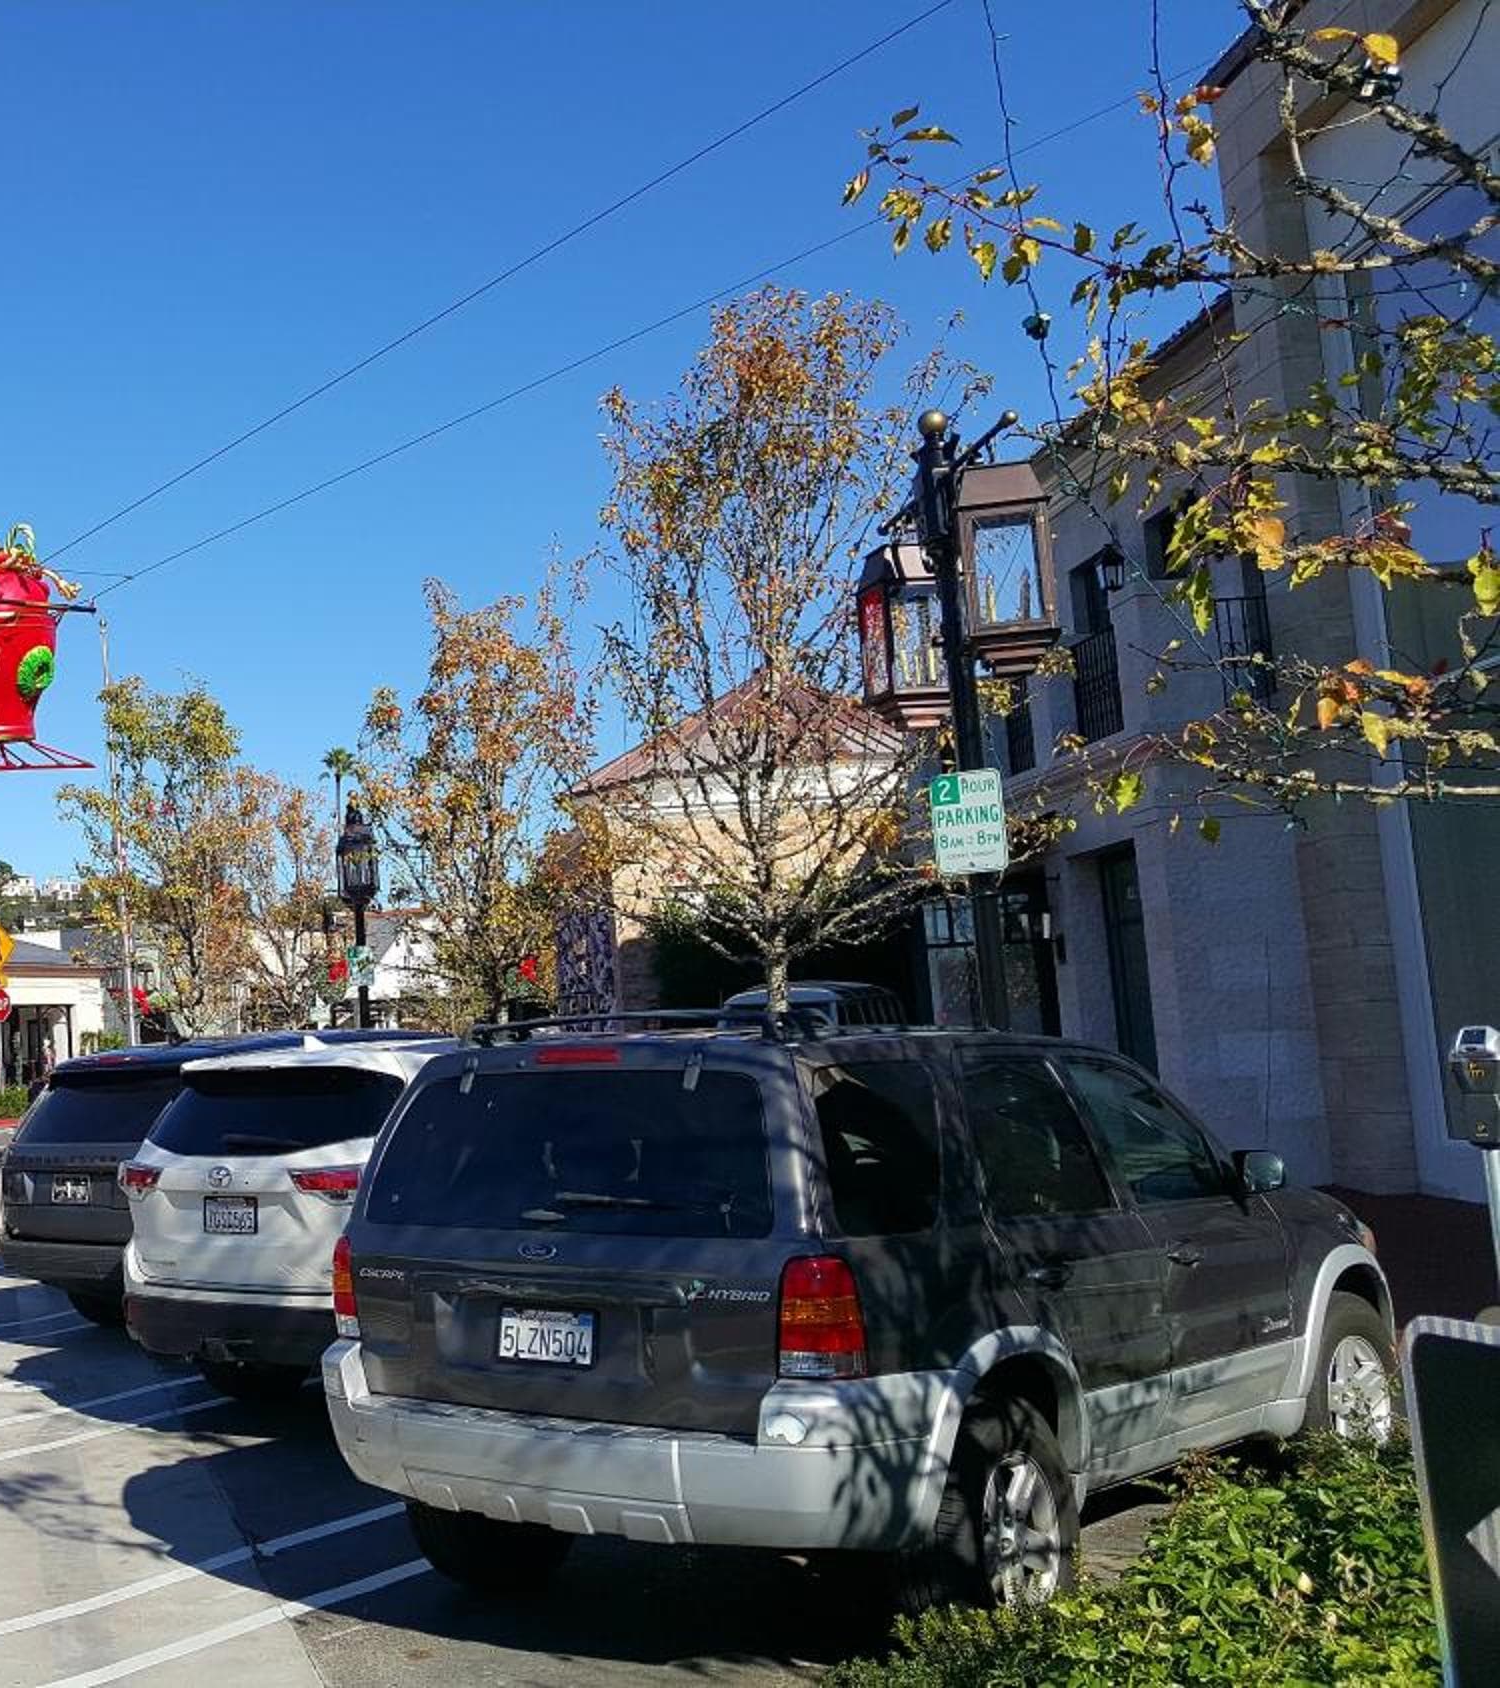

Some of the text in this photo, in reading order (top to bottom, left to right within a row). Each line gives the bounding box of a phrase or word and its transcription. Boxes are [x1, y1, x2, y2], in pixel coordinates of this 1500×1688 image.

[938, 777, 995, 801] 2 HOUR
[937, 803, 999, 828] PARKING
[707, 1289, 771, 1302] HYBRID
[503, 1325, 588, 1359] 5LZN504
